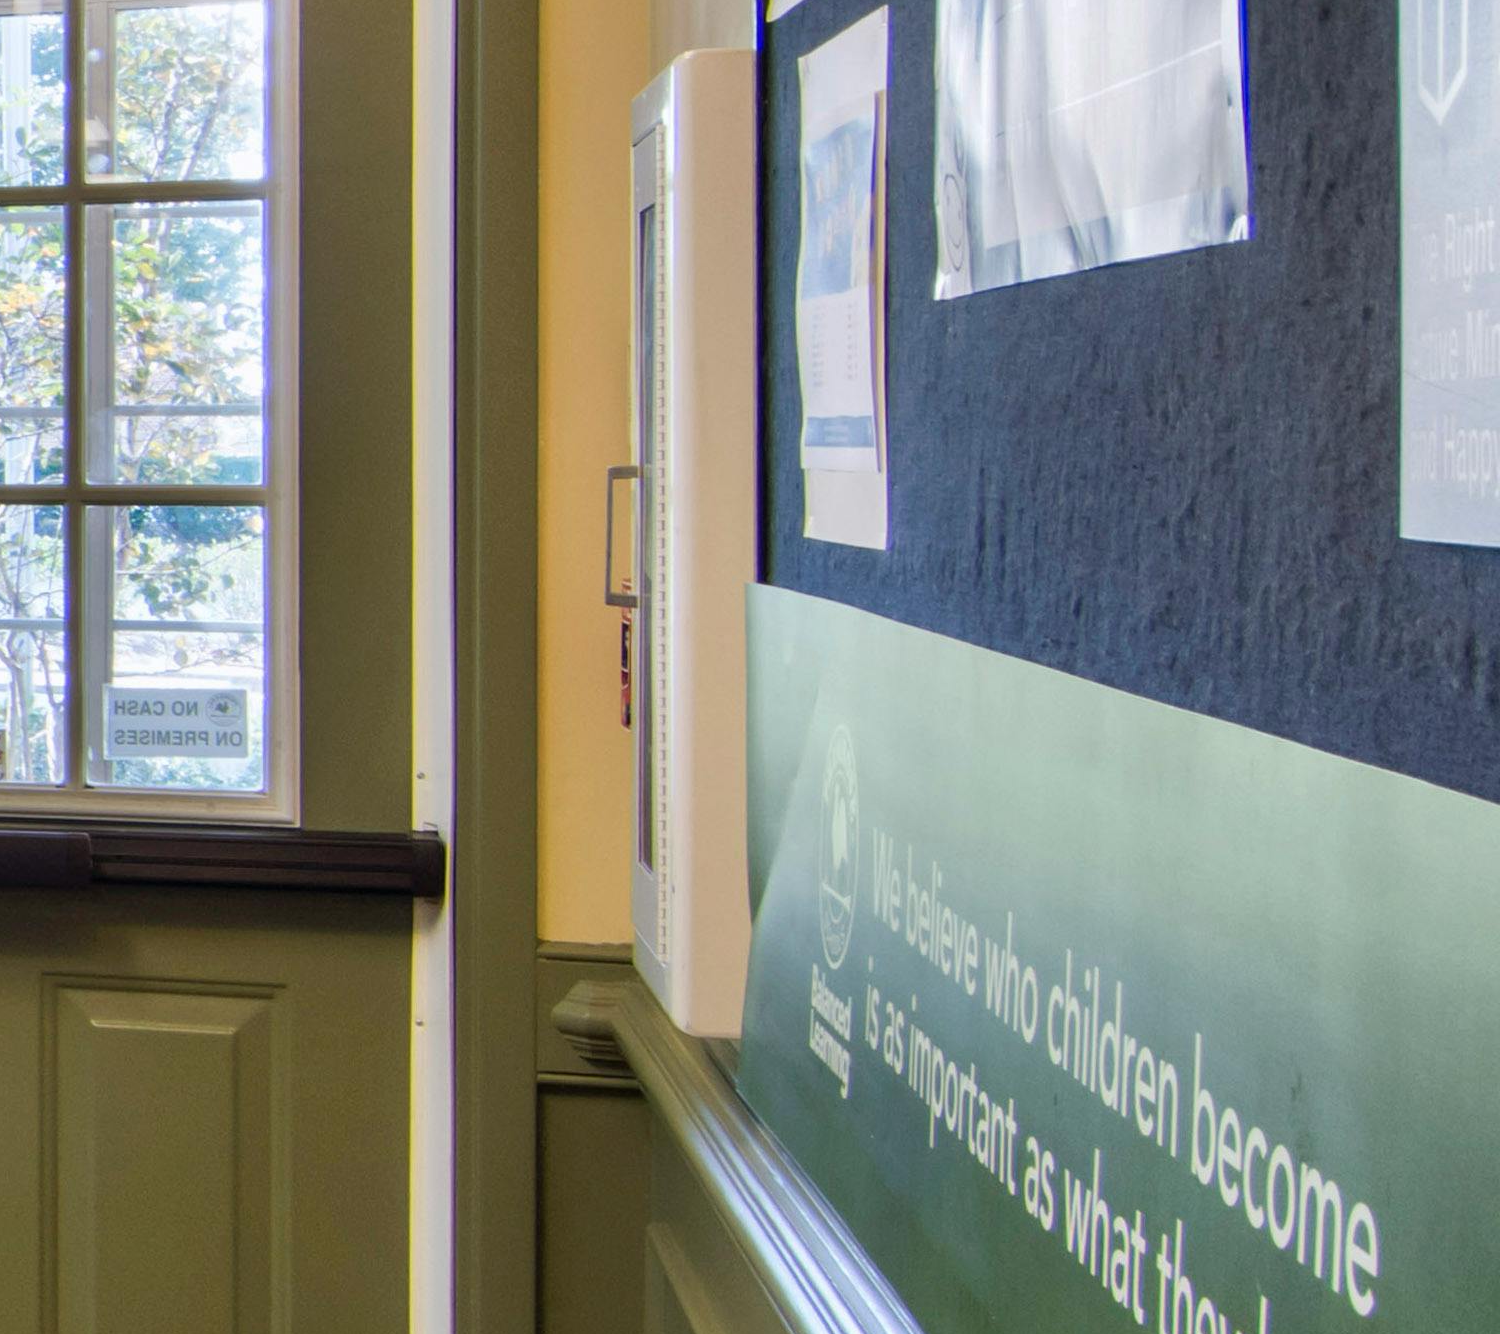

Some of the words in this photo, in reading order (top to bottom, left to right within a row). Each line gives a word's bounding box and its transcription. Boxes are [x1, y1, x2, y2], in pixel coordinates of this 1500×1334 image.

[1445, 204, 1496, 293] Right
[811, 962, 852, 1043] Balanced
[809, 1007, 851, 1100] Learning
[872, 826, 900, 932] We
[905, 843, 978, 996] believe
[985, 911, 1038, 1044] who
[1047, 947, 1179, 1158] children
[1190, 1031, 1380, 1317] become
[864, 955, 881, 1051] is
[883, 1001, 905, 1075] as
[908, 993, 1017, 1196] important
[1023, 1135, 1057, 1231] as
[1063, 1148, 1147, 1326] what
